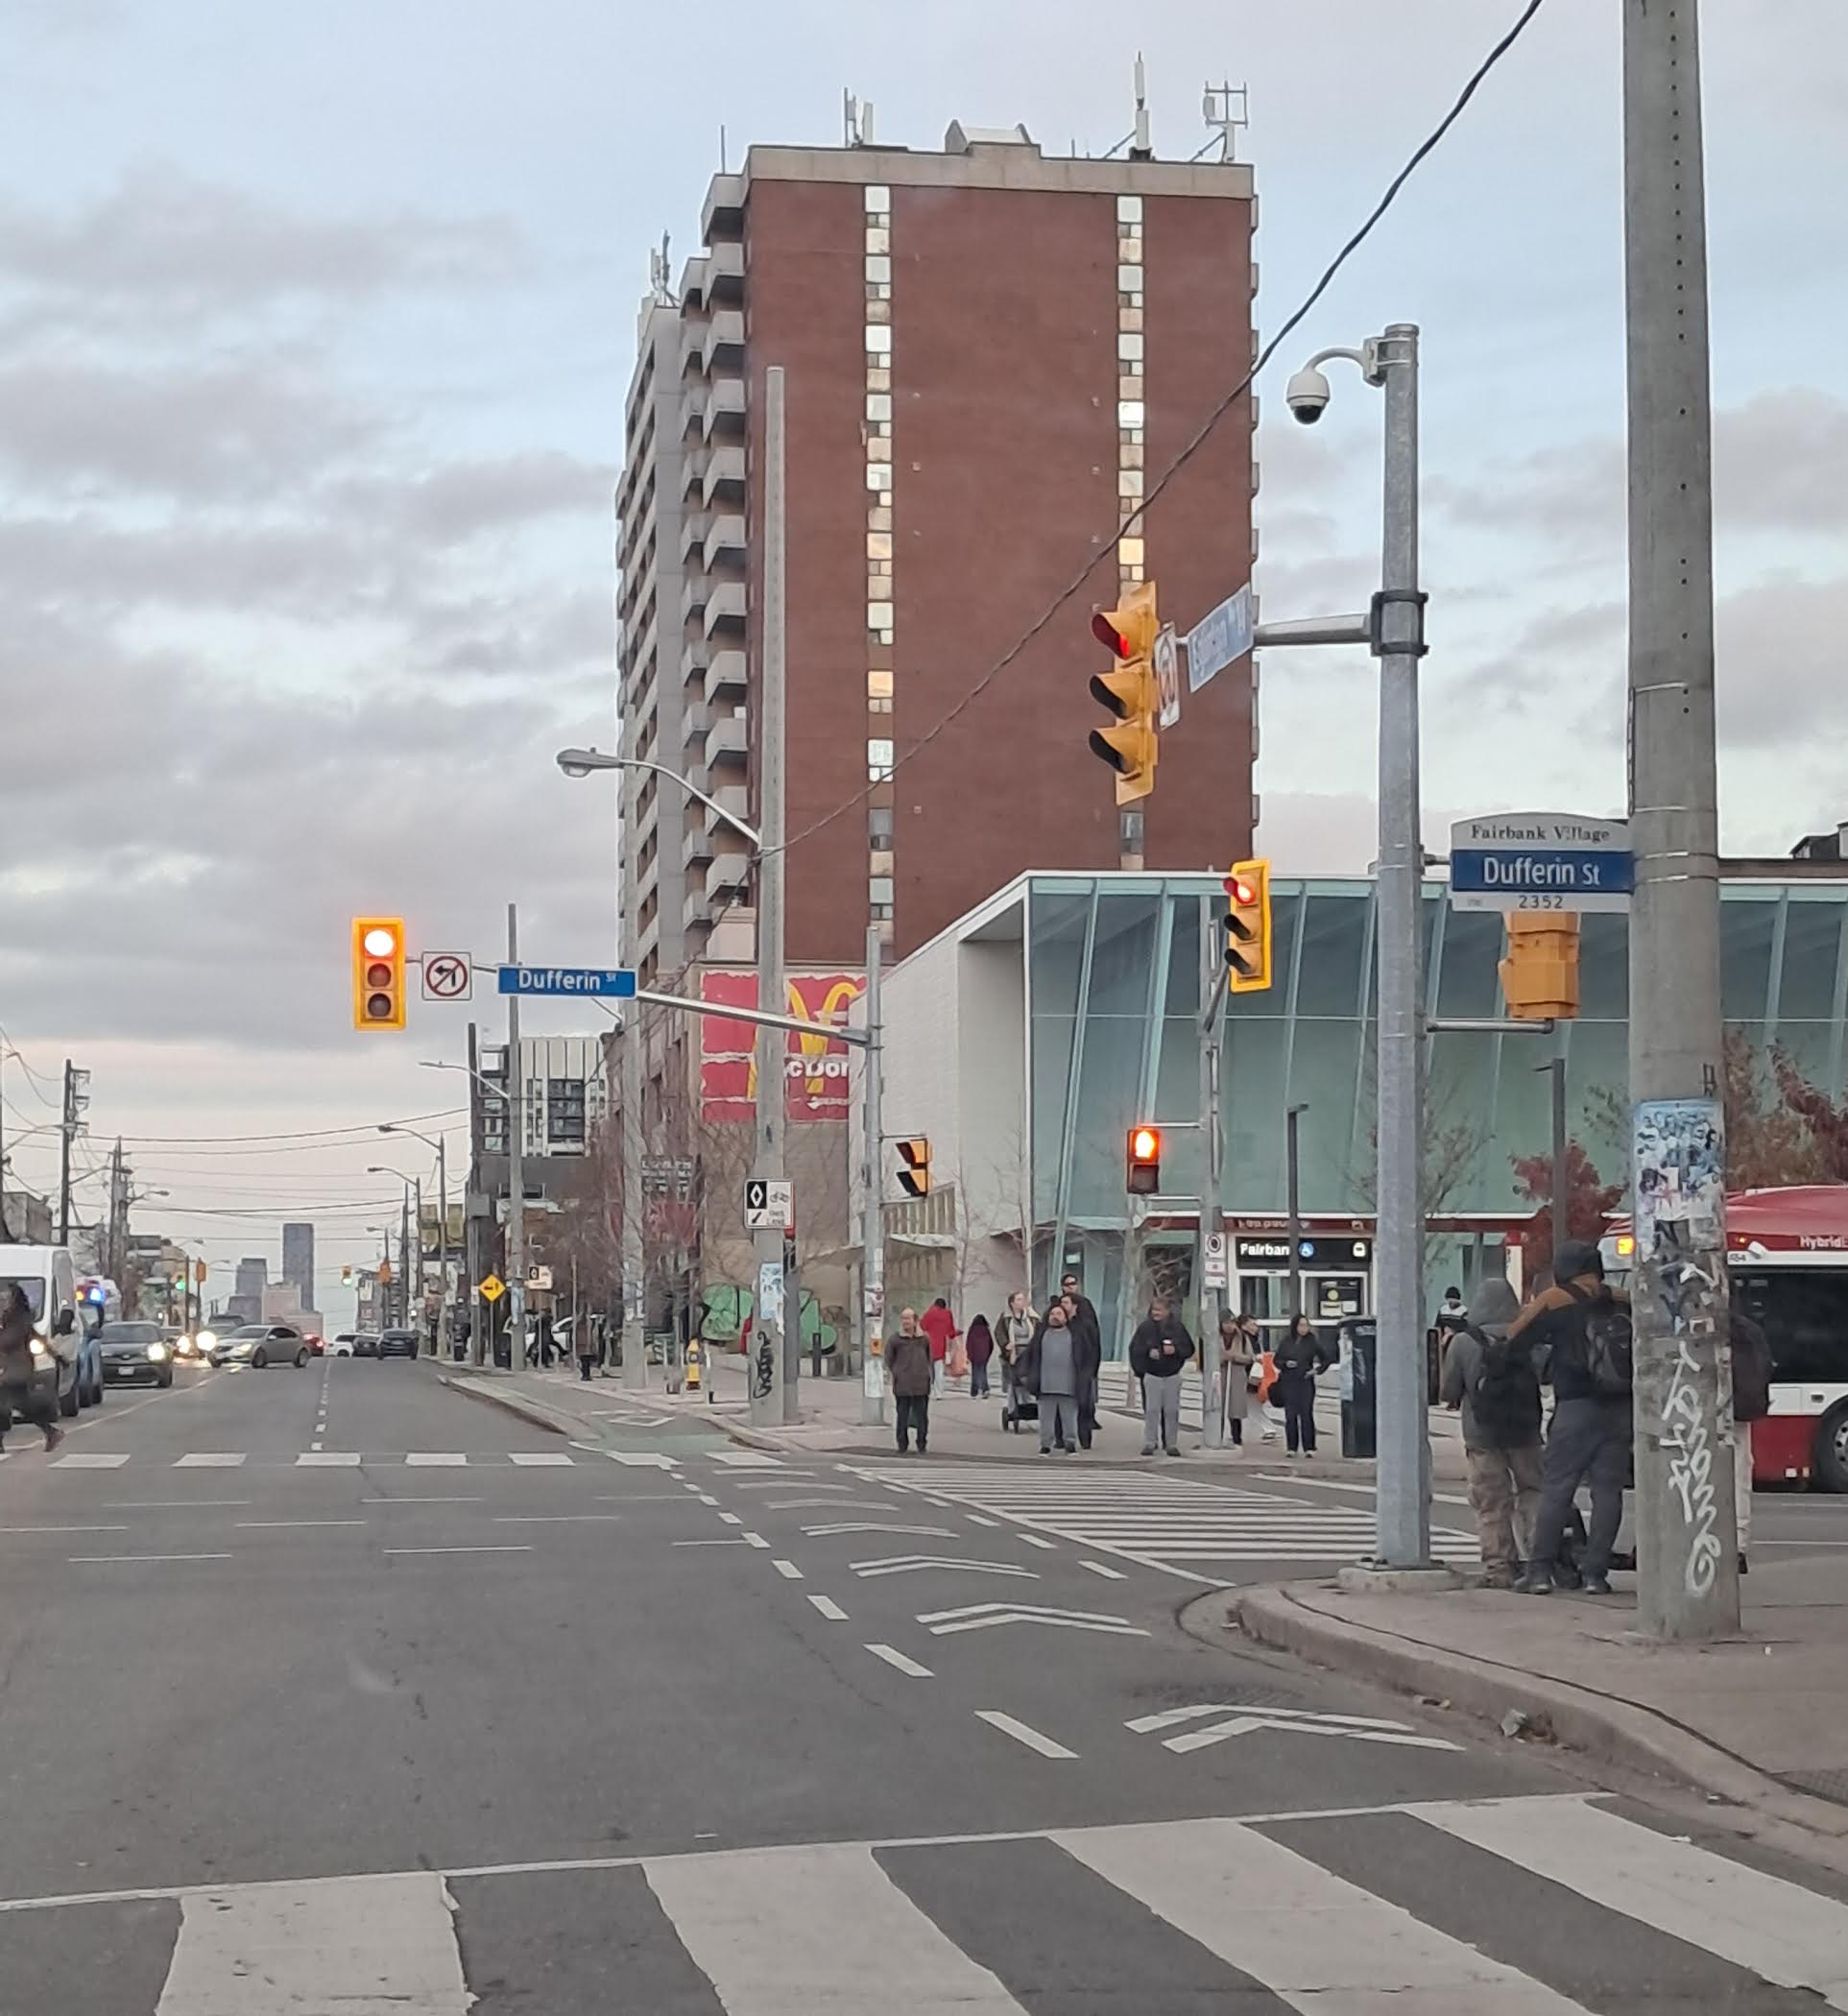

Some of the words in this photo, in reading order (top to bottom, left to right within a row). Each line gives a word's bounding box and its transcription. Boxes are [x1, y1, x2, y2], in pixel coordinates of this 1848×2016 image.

[1472, 825, 1546, 840] Fairbank
[1553, 826, 1610, 843] Village
[1483, 856, 1574, 885] Dufferin
[1582, 863, 1600, 885] St
[1519, 895, 1563, 909] 2352
[518, 970, 600, 991] Dufferin
[1239, 1243, 1291, 1257] Fairban
